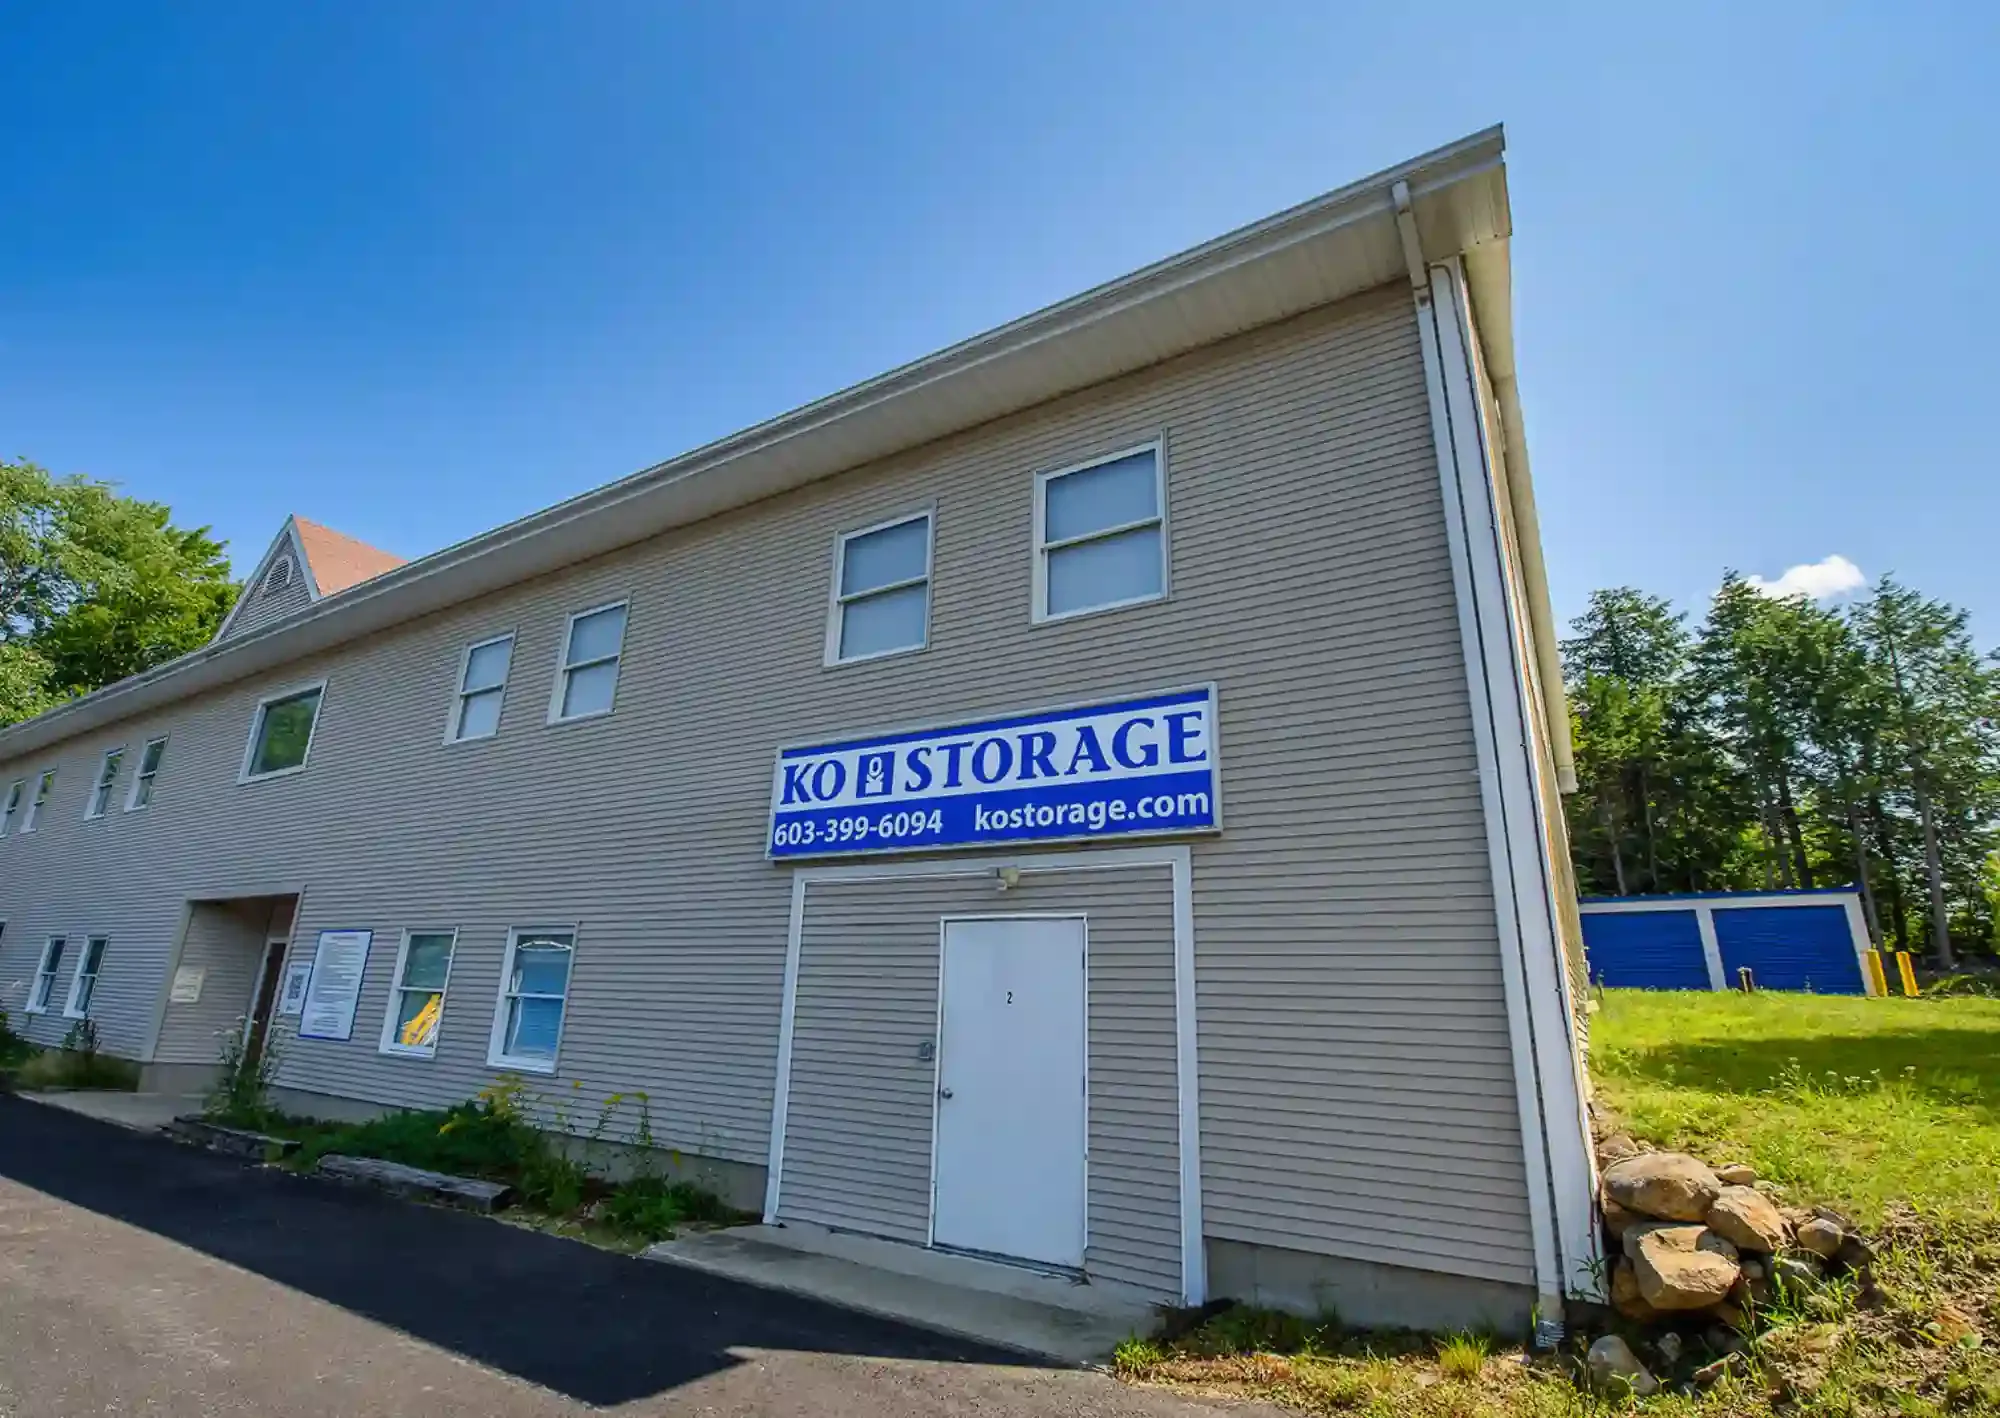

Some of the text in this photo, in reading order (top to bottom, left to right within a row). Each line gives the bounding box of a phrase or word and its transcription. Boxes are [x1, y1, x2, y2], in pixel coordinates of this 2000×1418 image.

[779, 710, 1207, 806] KO STORAGE
[774, 791, 1209, 846] 603-399-6094 kostorage.com
[1006, 991, 1013, 1005] 2
